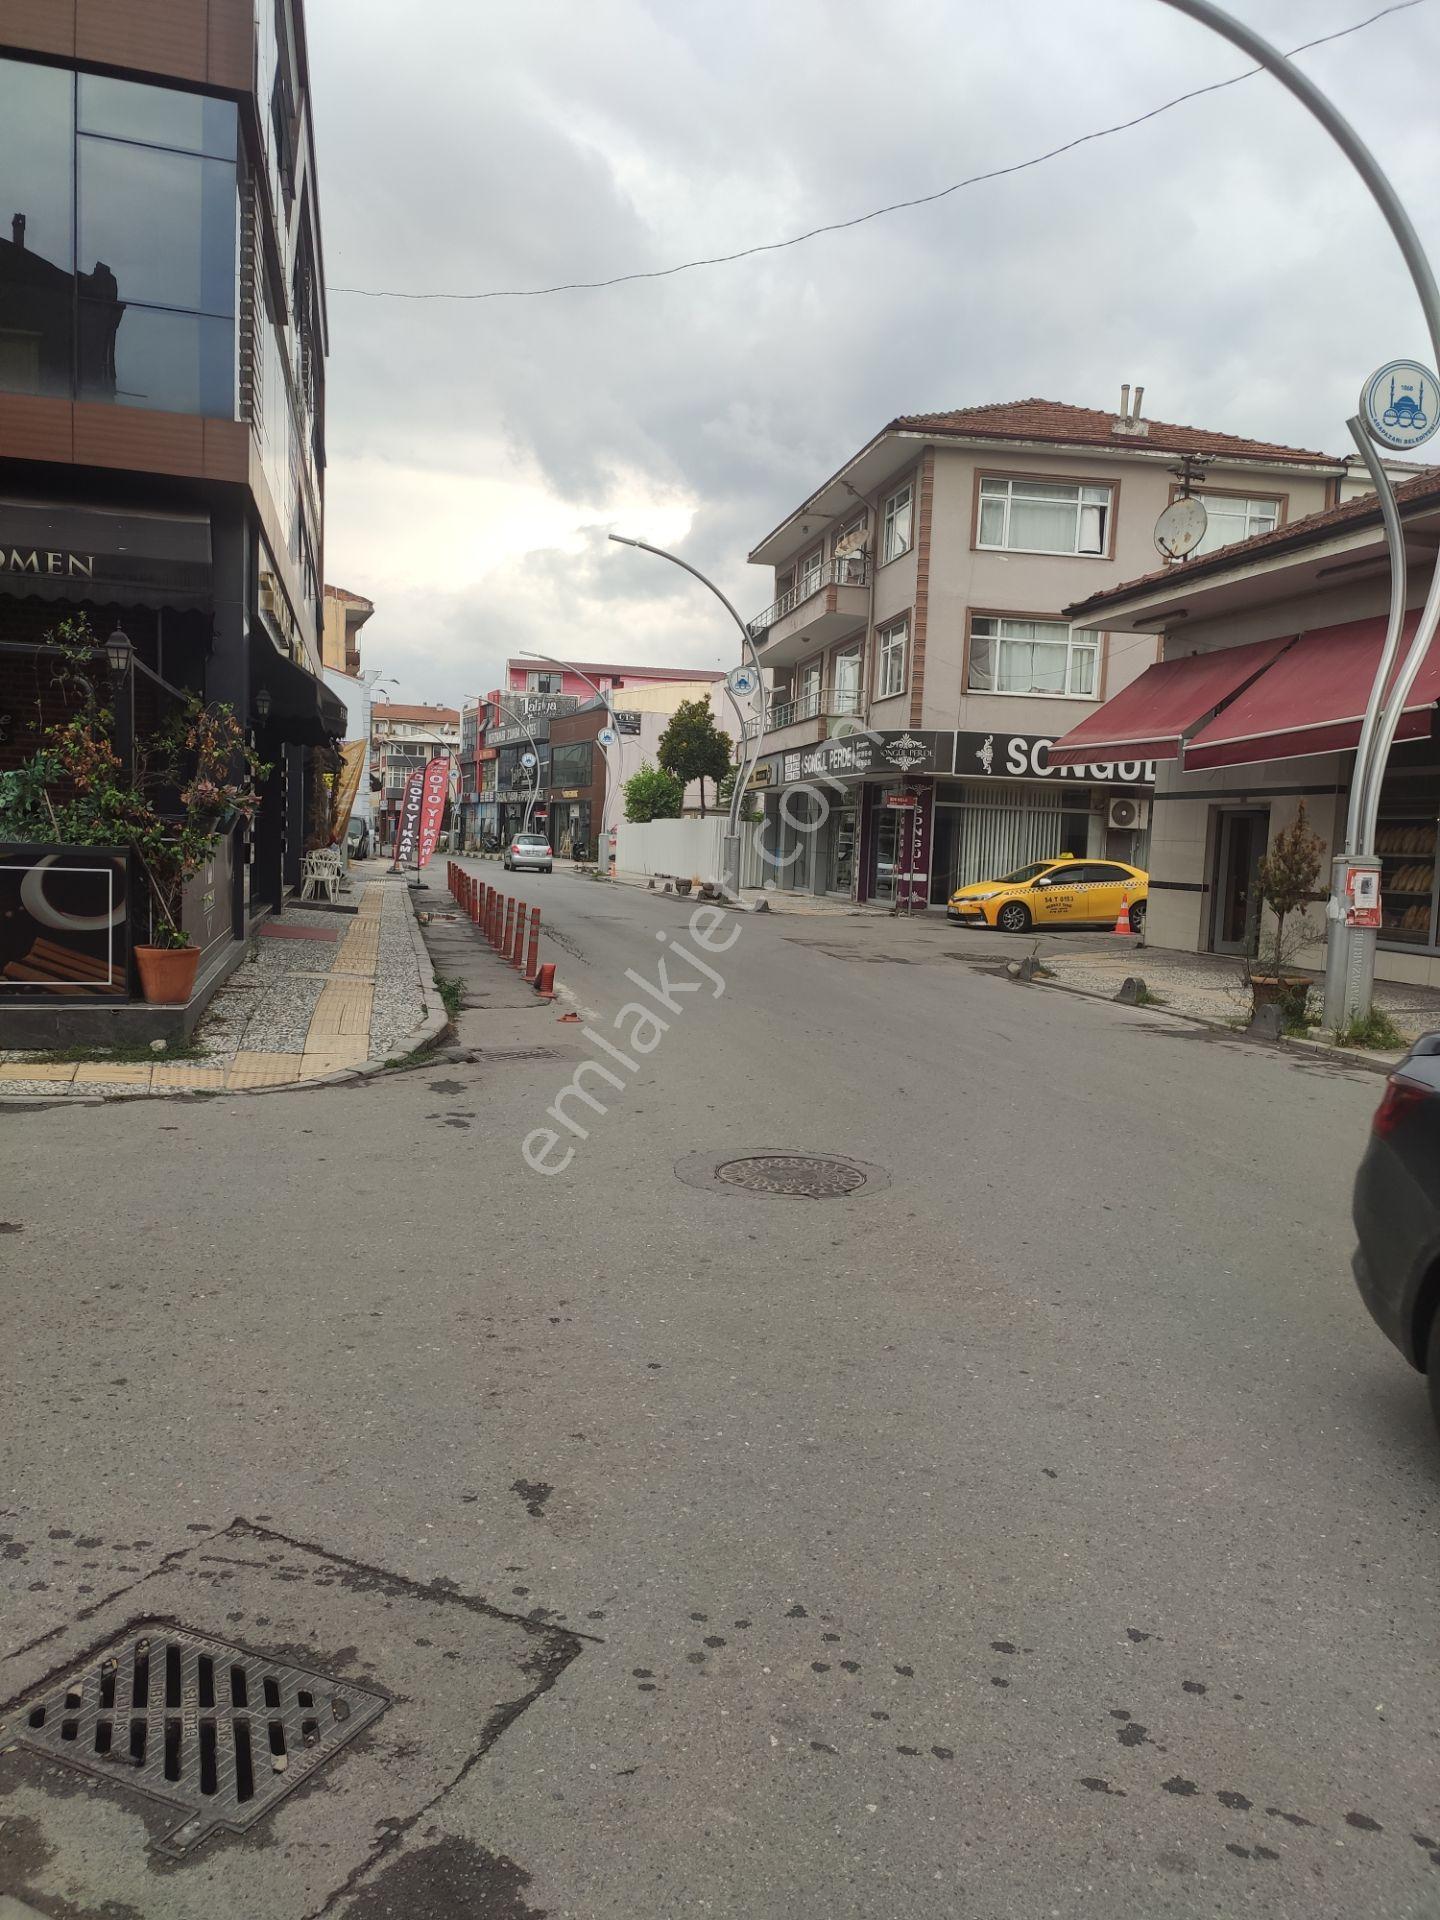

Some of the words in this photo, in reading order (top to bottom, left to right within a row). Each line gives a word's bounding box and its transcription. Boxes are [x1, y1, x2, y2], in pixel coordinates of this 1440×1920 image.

[0, 548, 95, 577] MEN
[407, 787, 422, 811] OTO
[427, 775, 443, 804] OTO
[398, 813, 418, 860] YIKAMA
